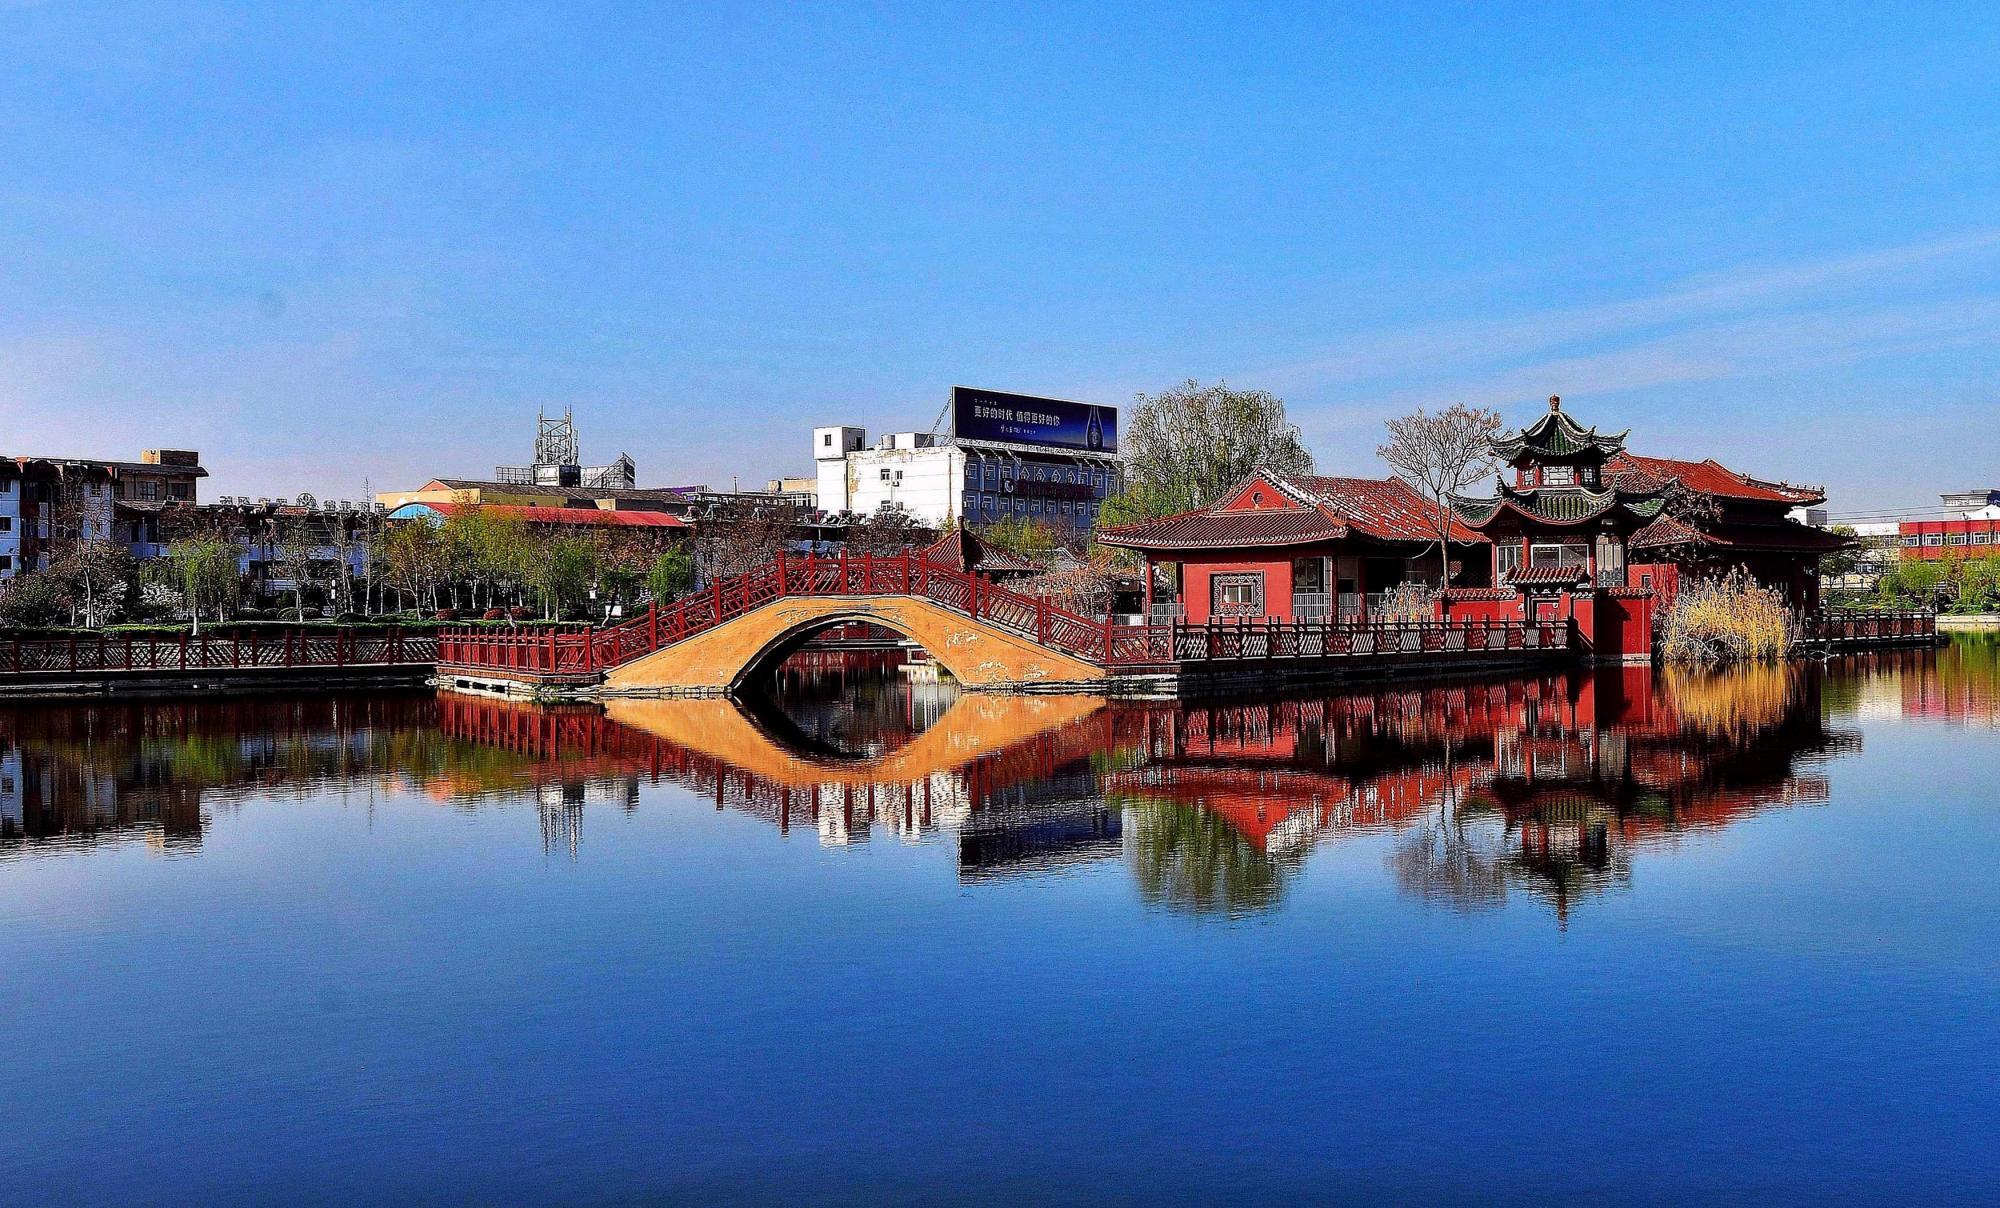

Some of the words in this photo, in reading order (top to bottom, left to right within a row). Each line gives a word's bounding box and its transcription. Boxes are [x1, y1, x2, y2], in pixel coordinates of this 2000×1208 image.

[974, 405, 1013, 421] 更好的时代
[1016, 411, 1061, 427] 值得更好的你
